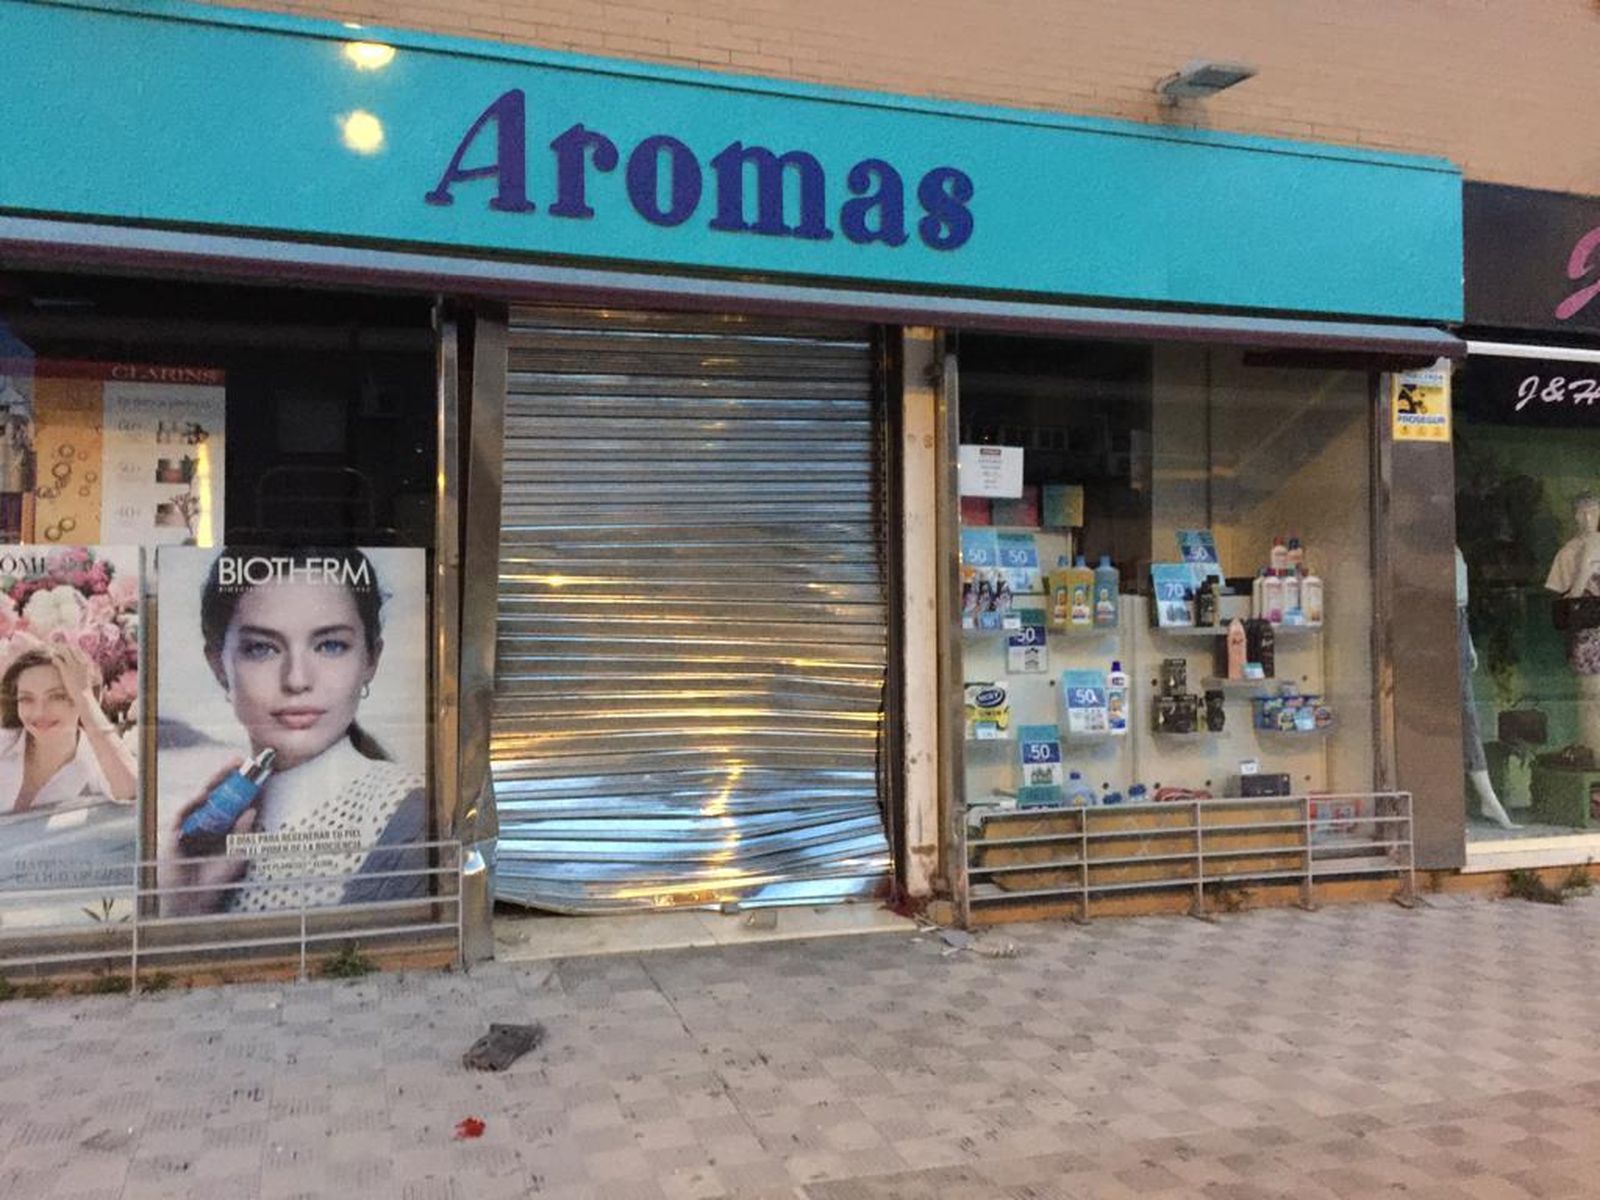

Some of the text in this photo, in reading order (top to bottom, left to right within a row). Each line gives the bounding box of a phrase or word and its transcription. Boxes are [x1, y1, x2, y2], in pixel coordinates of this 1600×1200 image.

[425, 88, 975, 251] Aromas
[111, 363, 219, 382] CLARINS
[967, 549, 988, 564] 50
[1008, 549, 1029, 564] 50
[218, 557, 371, 585] BIOTHERM
[1164, 582, 1185, 598] 70
[1017, 627, 1036, 642] 50
[1075, 688, 1096, 703] 50
[1029, 743, 1051, 760] 50
